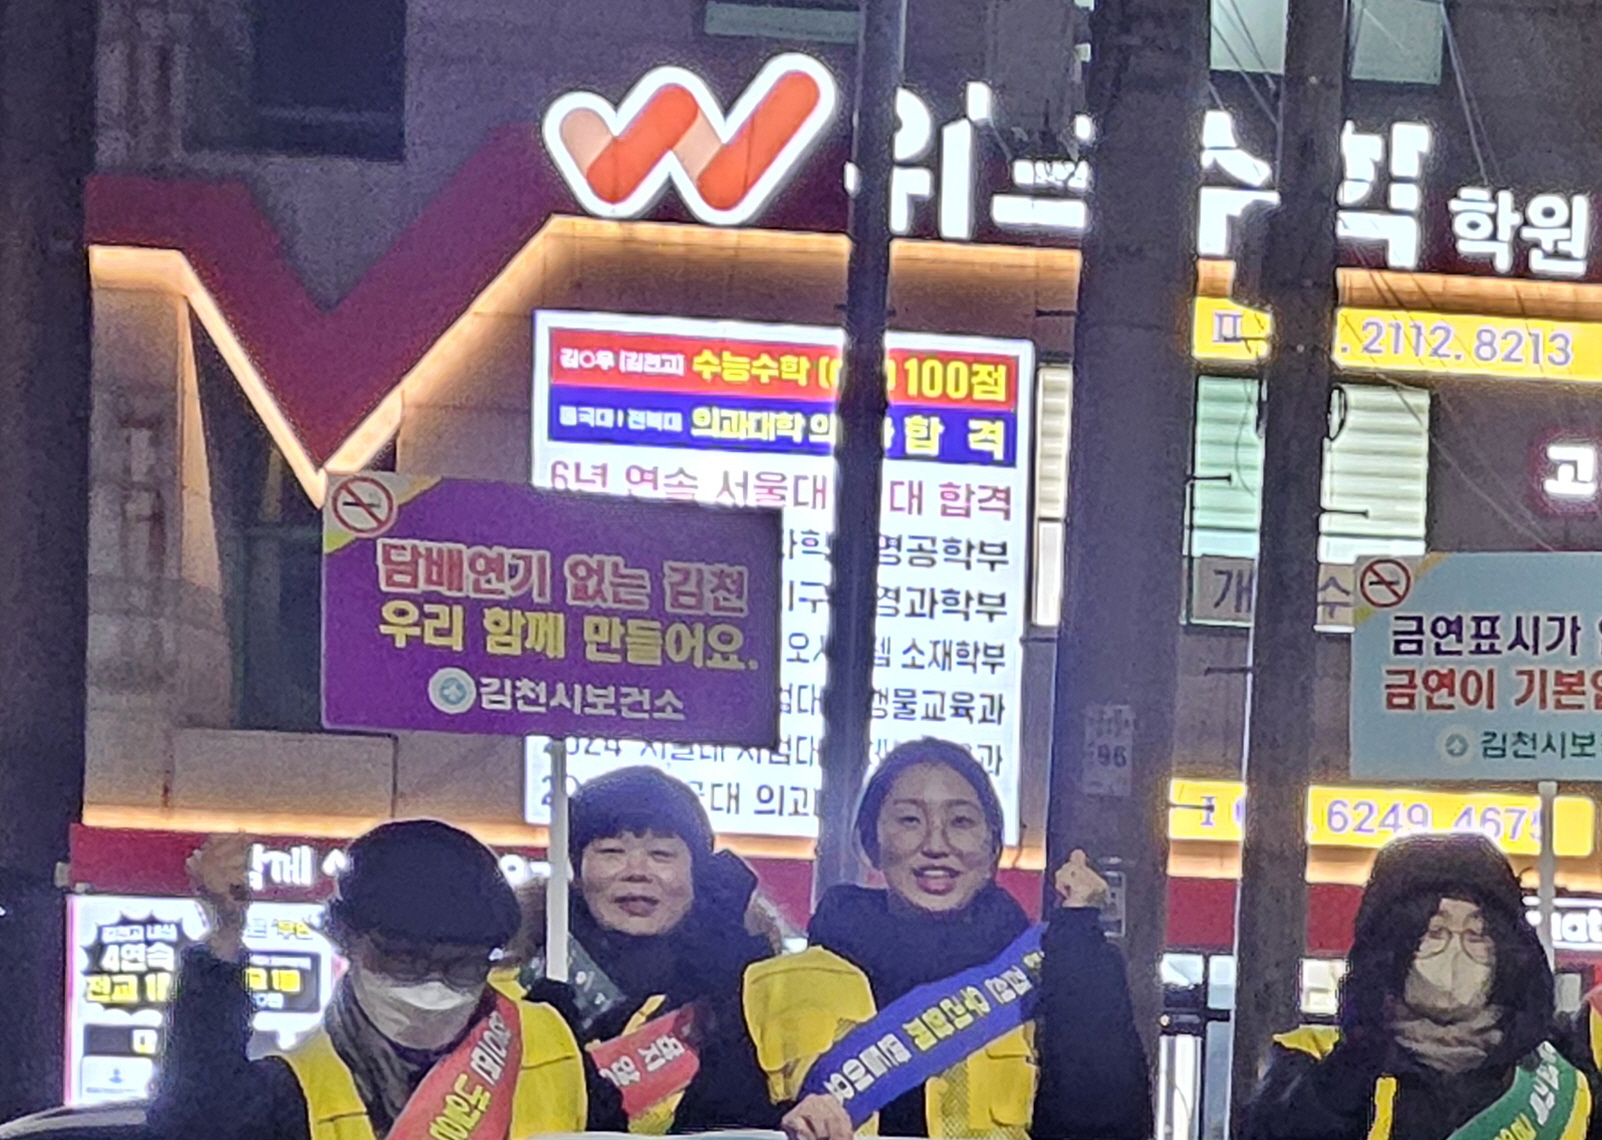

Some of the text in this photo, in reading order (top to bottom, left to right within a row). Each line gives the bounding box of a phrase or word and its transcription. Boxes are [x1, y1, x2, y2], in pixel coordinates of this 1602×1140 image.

[1449, 186, 1589, 276] 학원
[692, 349, 810, 387] 수능수학
[904, 357, 1007, 402] 100점
[716, 470, 827, 509] 서울대
[939, 482, 1012, 521] 합격
[376, 538, 550, 602] 담배연기
[565, 553, 651, 611] 없는
[664, 560, 748, 616] 김천
[379, 600, 463, 651] 우리
[483, 607, 566, 659] 함께
[583, 616, 758, 671] 만들어요.
[901, 638, 1006, 675] 소재학부
[1391, 616, 1581, 657] 금연표시가
[480, 677, 686, 721] 김천시보건소
[1384, 668, 1495, 711] 금연이
